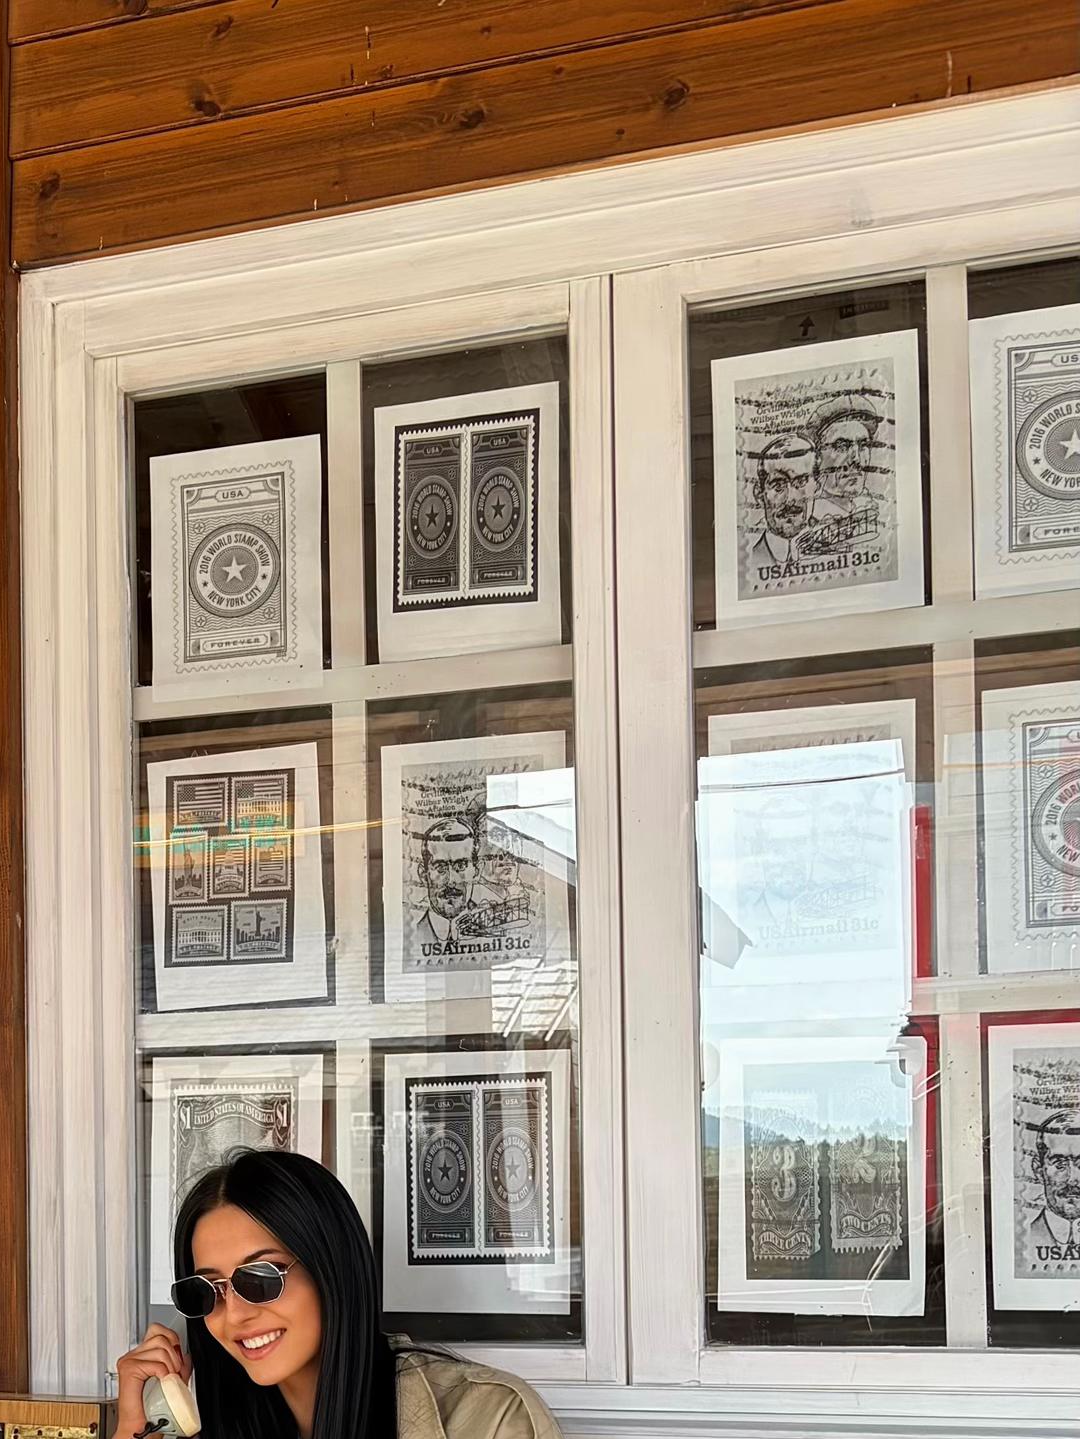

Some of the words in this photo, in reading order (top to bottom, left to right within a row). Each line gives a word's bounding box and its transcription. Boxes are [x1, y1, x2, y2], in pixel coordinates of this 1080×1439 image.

[1060, 354, 1080, 364] US
[750, 413, 780, 425] Wilbur
[780, 408, 811, 421] Wright
[1030, 428, 1045, 449] 2016
[1039, 402, 1072, 428] WORLD
[426, 447, 439, 455] USA
[1040, 468, 1060, 487] NEW
[1064, 474, 1080, 488] YOR
[222, 490, 244, 499] USA
[418, 484, 432, 503] WORLD
[432, 484, 447, 499] STAMP
[444, 496, 453, 516] SHOW
[483, 476, 497, 495] WORLD
[498, 475, 513, 489] STAMP
[510, 486, 520, 508] SHOW
[416, 532, 427, 549] NEW
[427, 540, 438, 550] YORK
[437, 532, 447, 548] CITY
[482, 525, 493, 541] NEW
[493, 531, 504, 542] YORK
[504, 525, 514, 540] CITY
[200, 555, 213, 575] 2016
[209, 537, 233, 556] WORLD
[234, 533, 258, 548] STAMP
[255, 544, 270, 567] SHOW
[758, 555, 849, 581] USAirmail
[852, 550, 880, 566] 31c
[207, 590, 224, 607] NEW
[225, 596, 245, 608] YORK
[245, 585, 262, 602] CITY
[441, 795, 469, 806] Wright
[1045, 803, 1062, 826] 2016
[1056, 844, 1080, 863] NEW
[421, 938, 502, 957] USAirmail
[505, 936, 530, 949] 31c
[1061, 1083, 1080, 1094] Wri
[505, 1098, 519, 1106] USA
[180, 1104, 191, 1132] $1
[194, 1111, 215, 1125] UNITED
[214, 1102, 237, 1115] STATES
[236, 1102, 244, 1113] OF
[244, 1103, 274, 1123] AMERICA
[276, 1103, 288, 1131] $1
[497, 1136, 512, 1154] WORLD
[430, 1138, 445, 1156] WORLD
[457, 1150, 466, 1172] SHOW
[771, 1145, 797, 1202] 3
[430, 1186, 441, 1202] NEW
[440, 1193, 452, 1204] YORK
[451, 1187, 461, 1202] CITY
[497, 1185, 508, 1200] NEW
[519, 1186, 529, 1201] CITY
[841, 1214, 861, 1230] TWO
[861, 1214, 892, 1232] CENTS
[759, 1231, 785, 1250] THREE
[785, 1232, 811, 1250] CENTS
